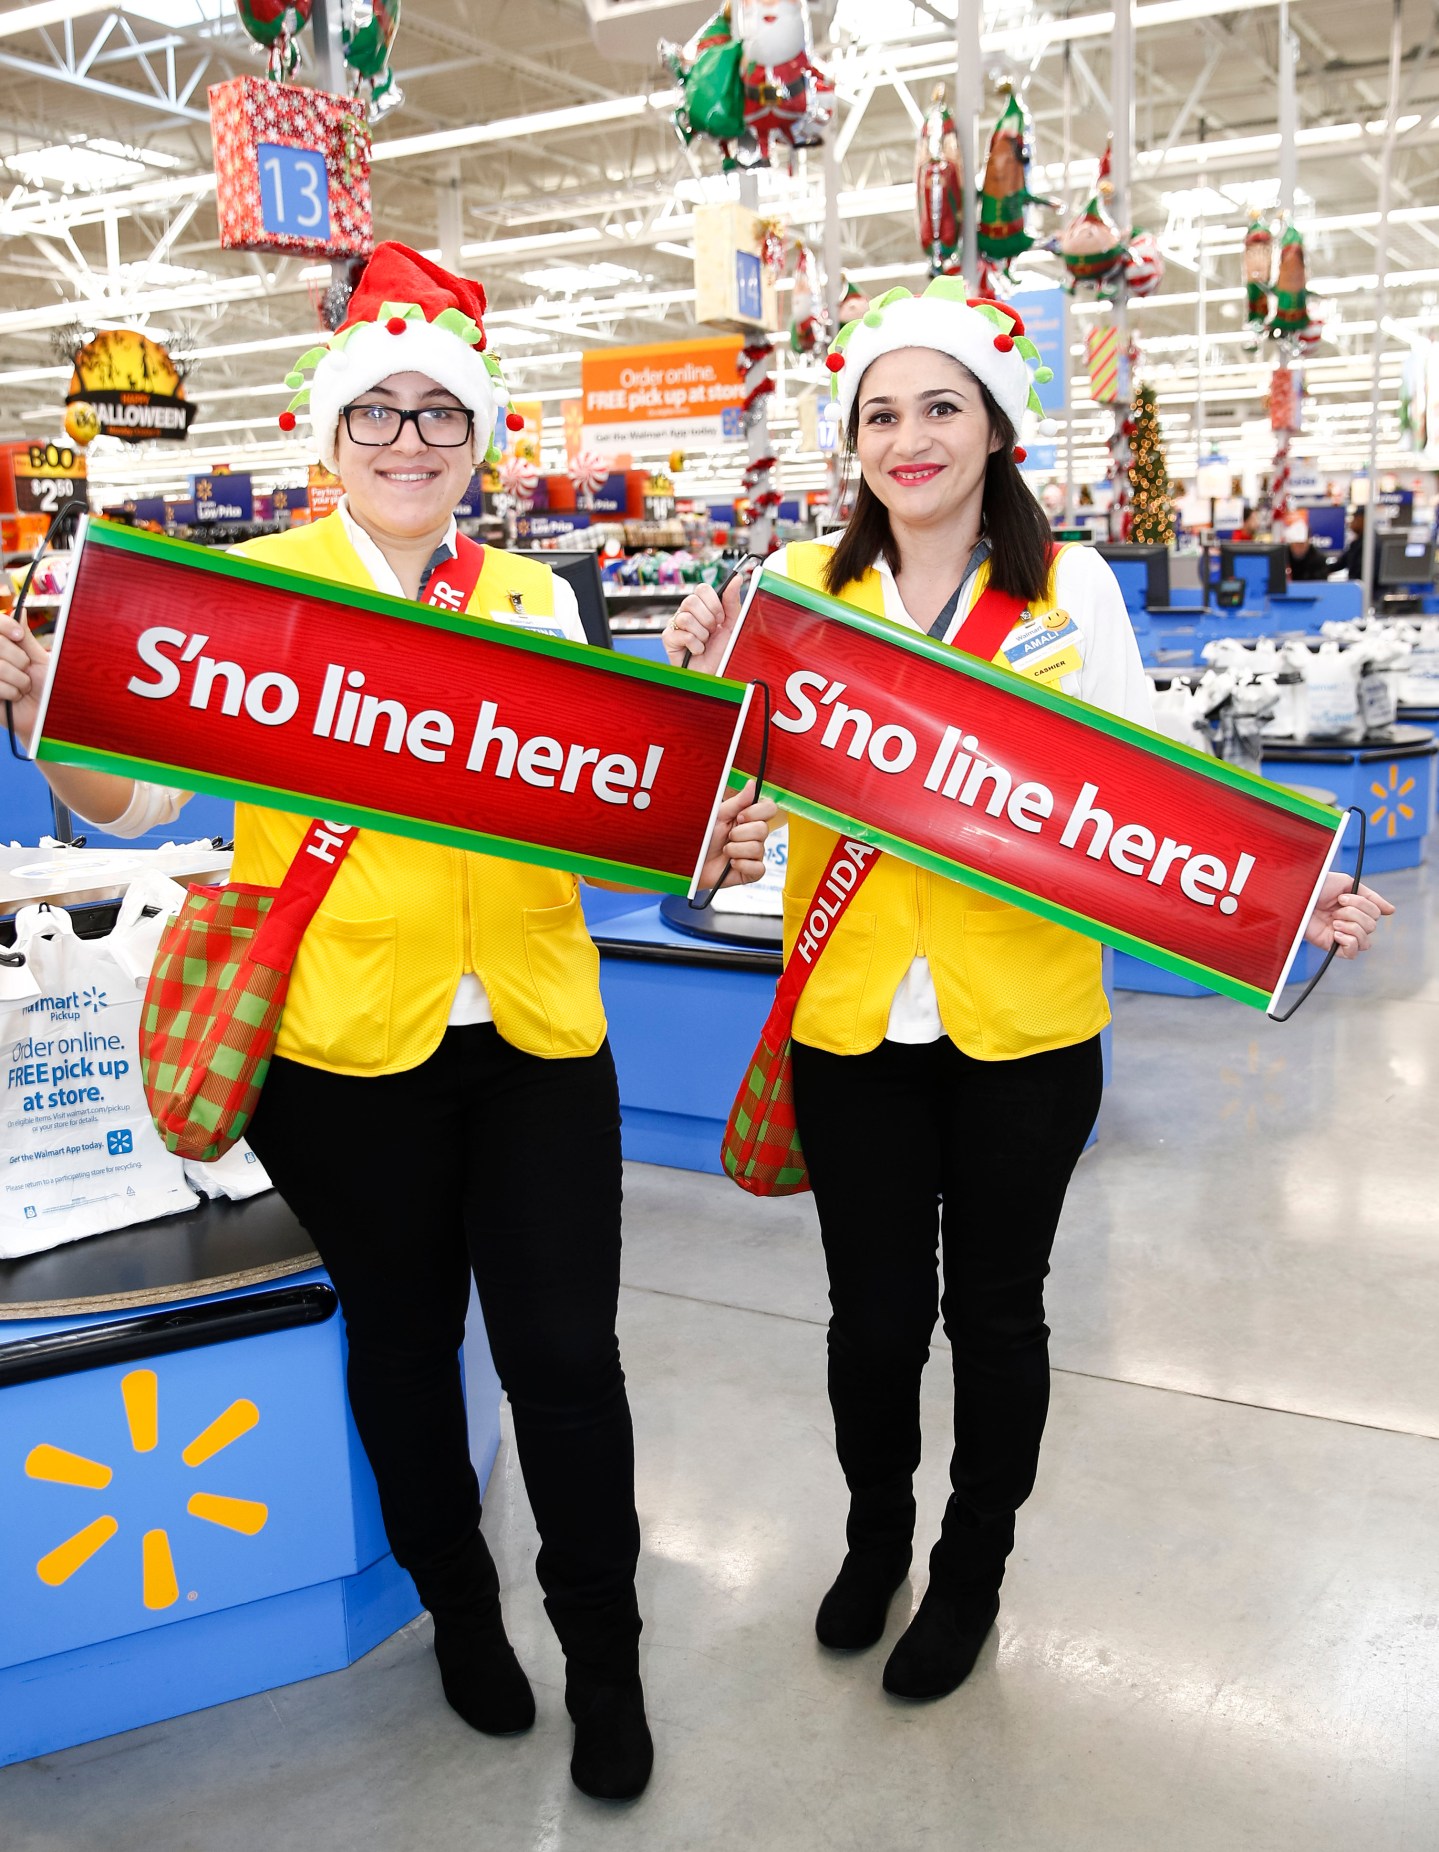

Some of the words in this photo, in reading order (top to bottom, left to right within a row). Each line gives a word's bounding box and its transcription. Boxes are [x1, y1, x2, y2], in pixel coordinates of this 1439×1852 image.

[264, 157, 324, 228] 13
[619, 365, 664, 389] Order
[665, 363, 718, 385] online.
[587, 389, 627, 411] FREE
[628, 386, 664, 412] pick
[664, 387, 687, 410] up
[688, 385, 706, 404] at
[1015, 625, 1043, 642] Walmart
[1034, 660, 1066, 677] CASHIER
[127, 626, 300, 726] S'no
[312, 663, 455, 764] line
[465, 700, 665, 810] here!
[770, 670, 918, 774] S'no
[923, 725, 1054, 834] line
[1059, 781, 1257, 916] here!
[797, 840, 876, 964] HOLIDA
[50, 1010, 81, 1022] Pickup
[12, 1037, 54, 1063] Order
[58, 1031, 125, 1054] online.
[8, 1062, 50, 1090] FREE
[52, 1056, 95, 1087] pick
[98, 1058, 130, 1080] up
[23, 1091, 45, 1112] at
[48, 1085, 105, 1109] store.
[66, 1103, 131, 1118] walmart.com/pickup
[39, 1123, 53, 1133] your
[53, 1119, 69, 1129] store
[69, 1117, 78, 1127] for
[9, 1155, 21, 1164] Get
[21, 1153, 34, 1162] the
[34, 1146, 65, 1160] Walmart
[66, 1144, 81, 1156] App
[81, 1140, 105, 1153] today.
[5, 1181, 25, 1193] Please
[25, 1178, 43, 1189] return
[54, 1170, 91, 1185] participating
[90, 1168, 106, 1177] store
[105, 1165, 115, 1174] for
[114, 1160, 143, 1172] recycling.
